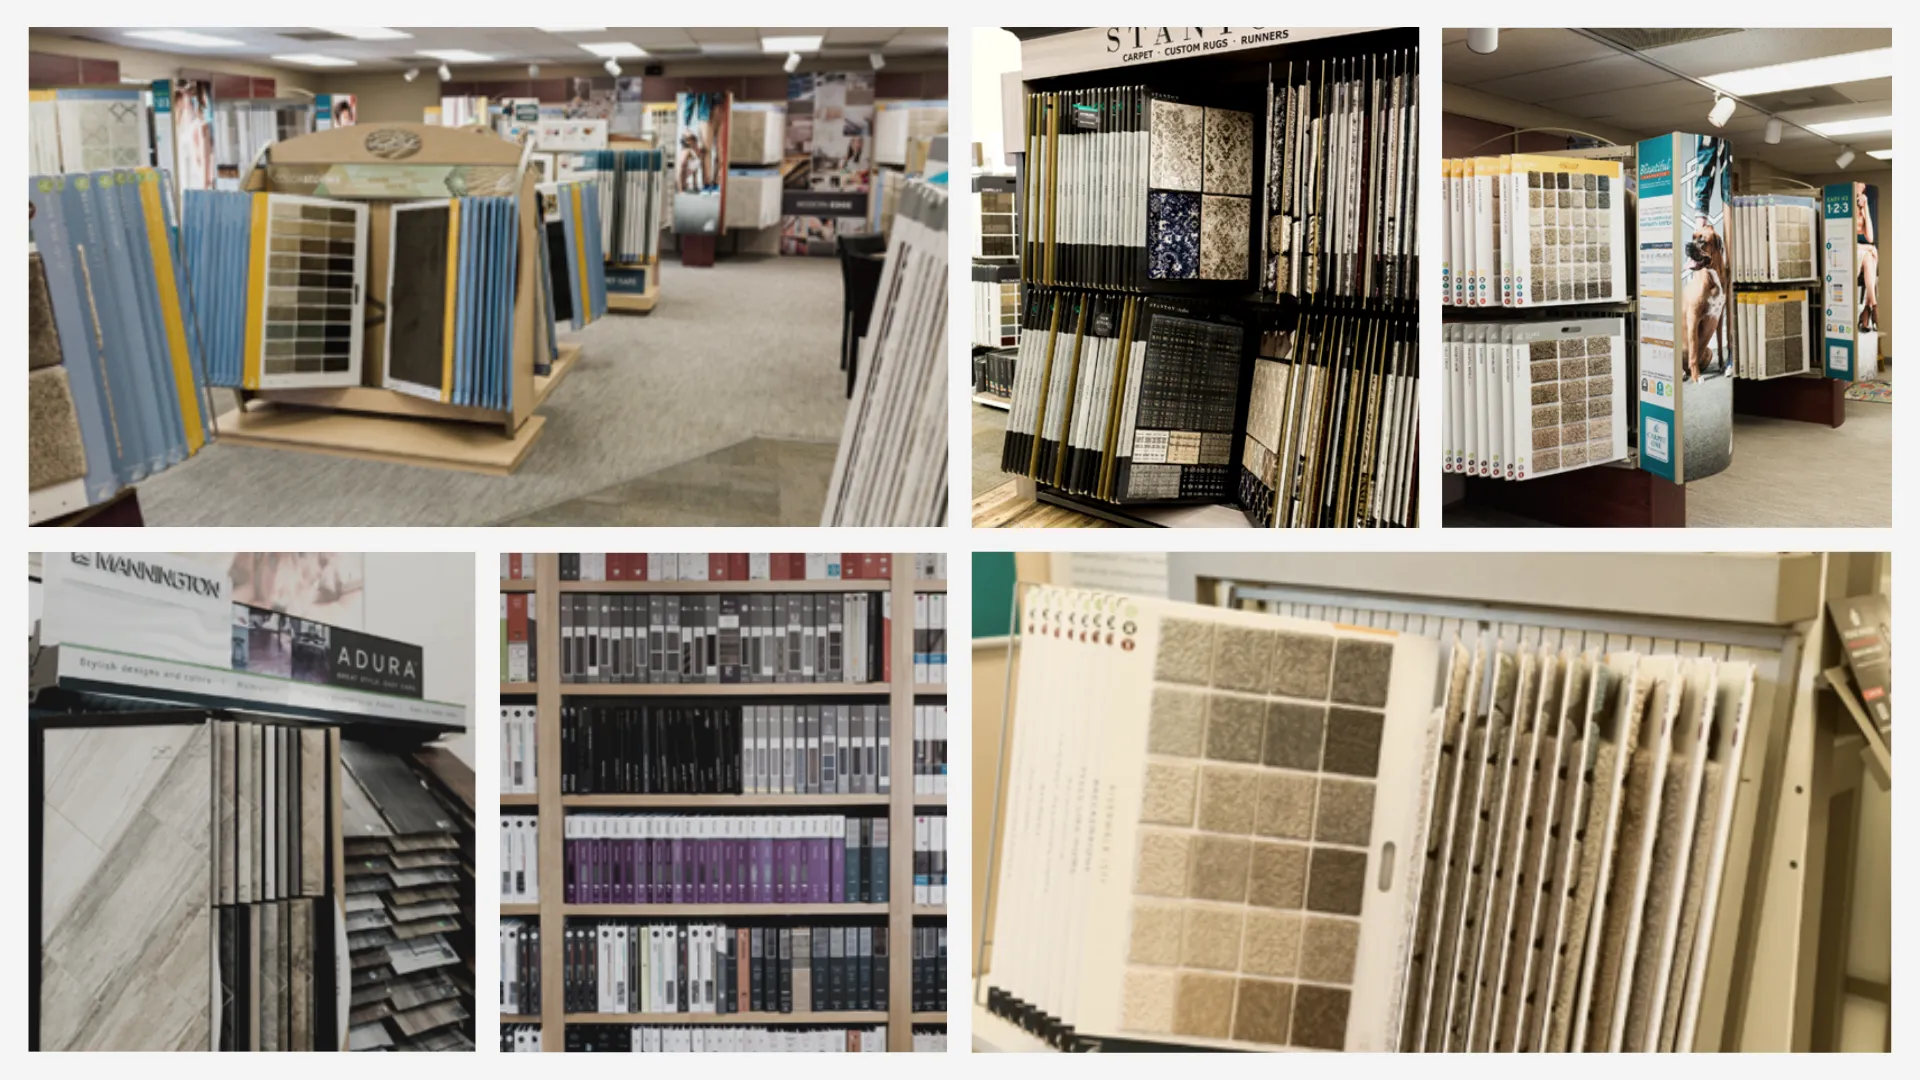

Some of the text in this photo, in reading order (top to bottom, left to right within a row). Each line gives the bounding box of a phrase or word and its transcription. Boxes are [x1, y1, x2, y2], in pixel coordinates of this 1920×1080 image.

[1122, 29, 1289, 62] CARPET CUSTOM RUGS RUNNERS
[95, 552, 220, 599] MANNINGTON
[121, 663, 160, 678] designs
[163, 670, 181, 681] and
[337, 646, 416, 679] ADURA
